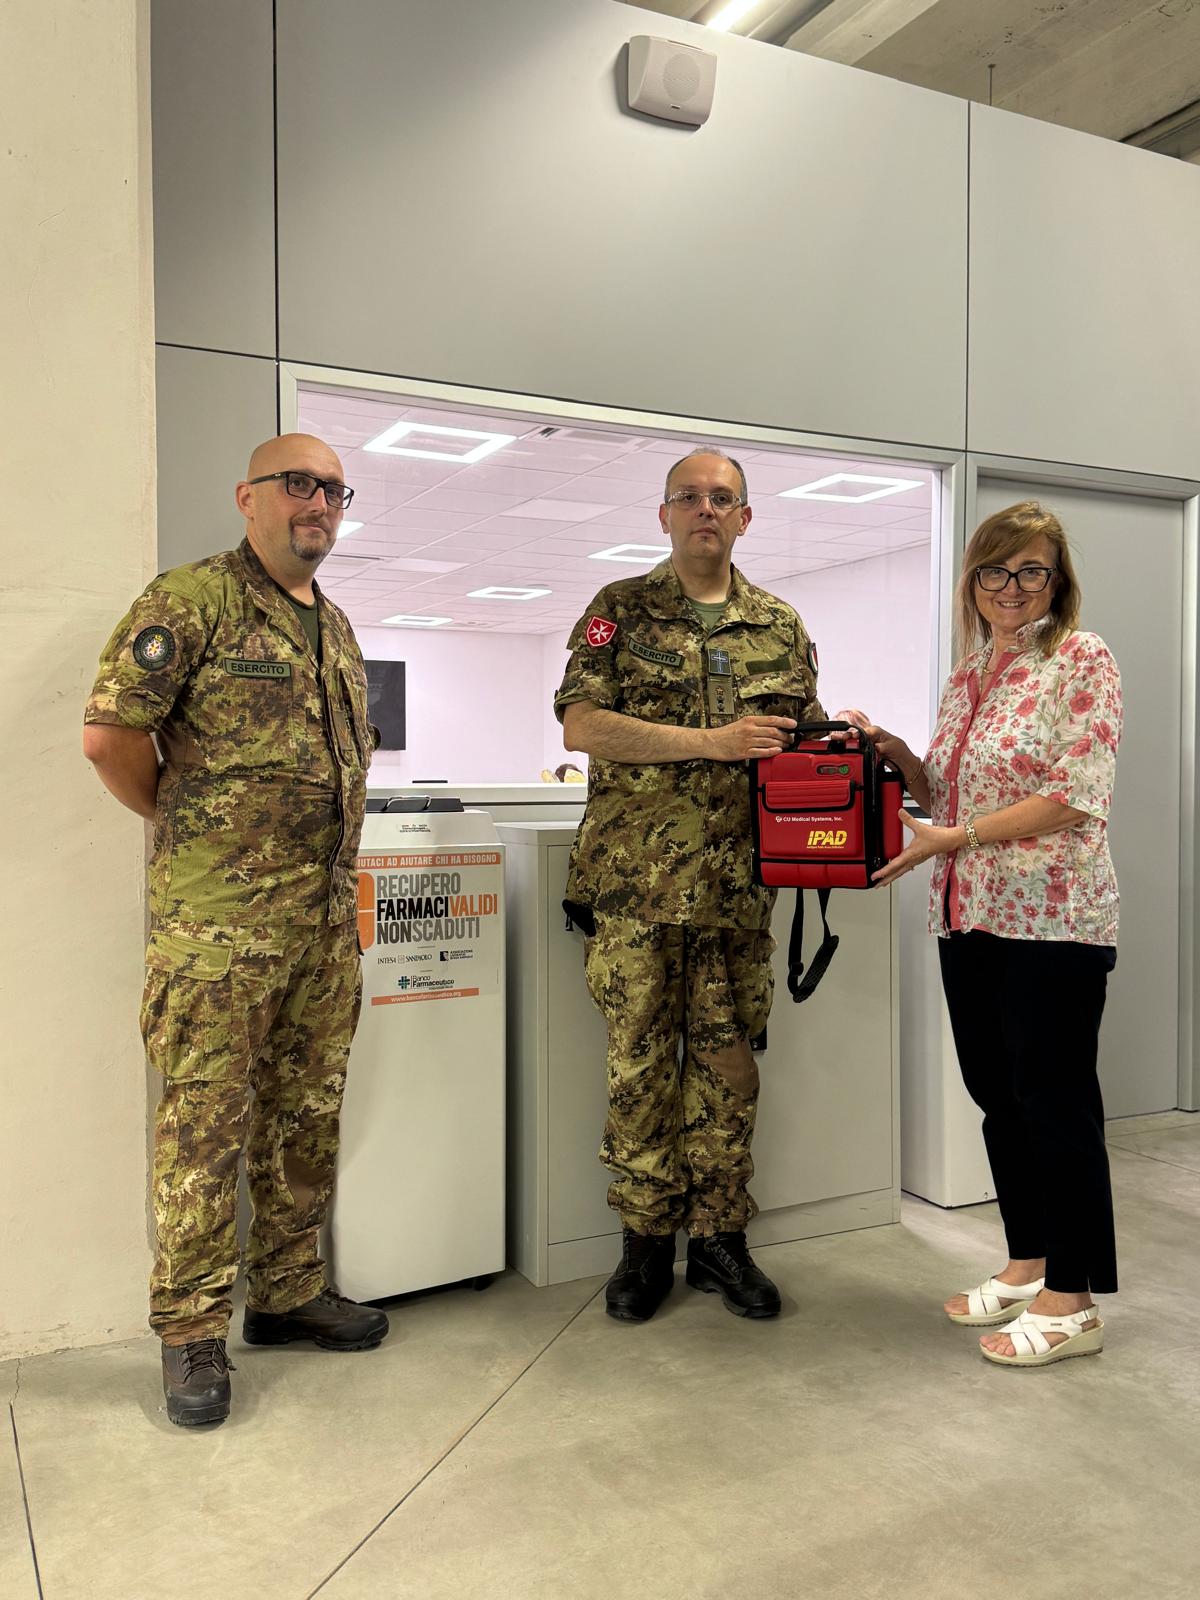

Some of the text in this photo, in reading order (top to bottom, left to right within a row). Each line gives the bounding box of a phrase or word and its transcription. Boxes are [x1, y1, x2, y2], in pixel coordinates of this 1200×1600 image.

[632, 644, 677, 663] ESERCITO
[231, 662, 285, 675] ESERCITO
[808, 830, 847, 846] IPAD
[358, 854, 497, 868] IUTACI AD AIUTARE CHI HA BISOGNO
[376, 872, 461, 899] RECUPERO
[412, 979, 455, 988] Farmaceutico
